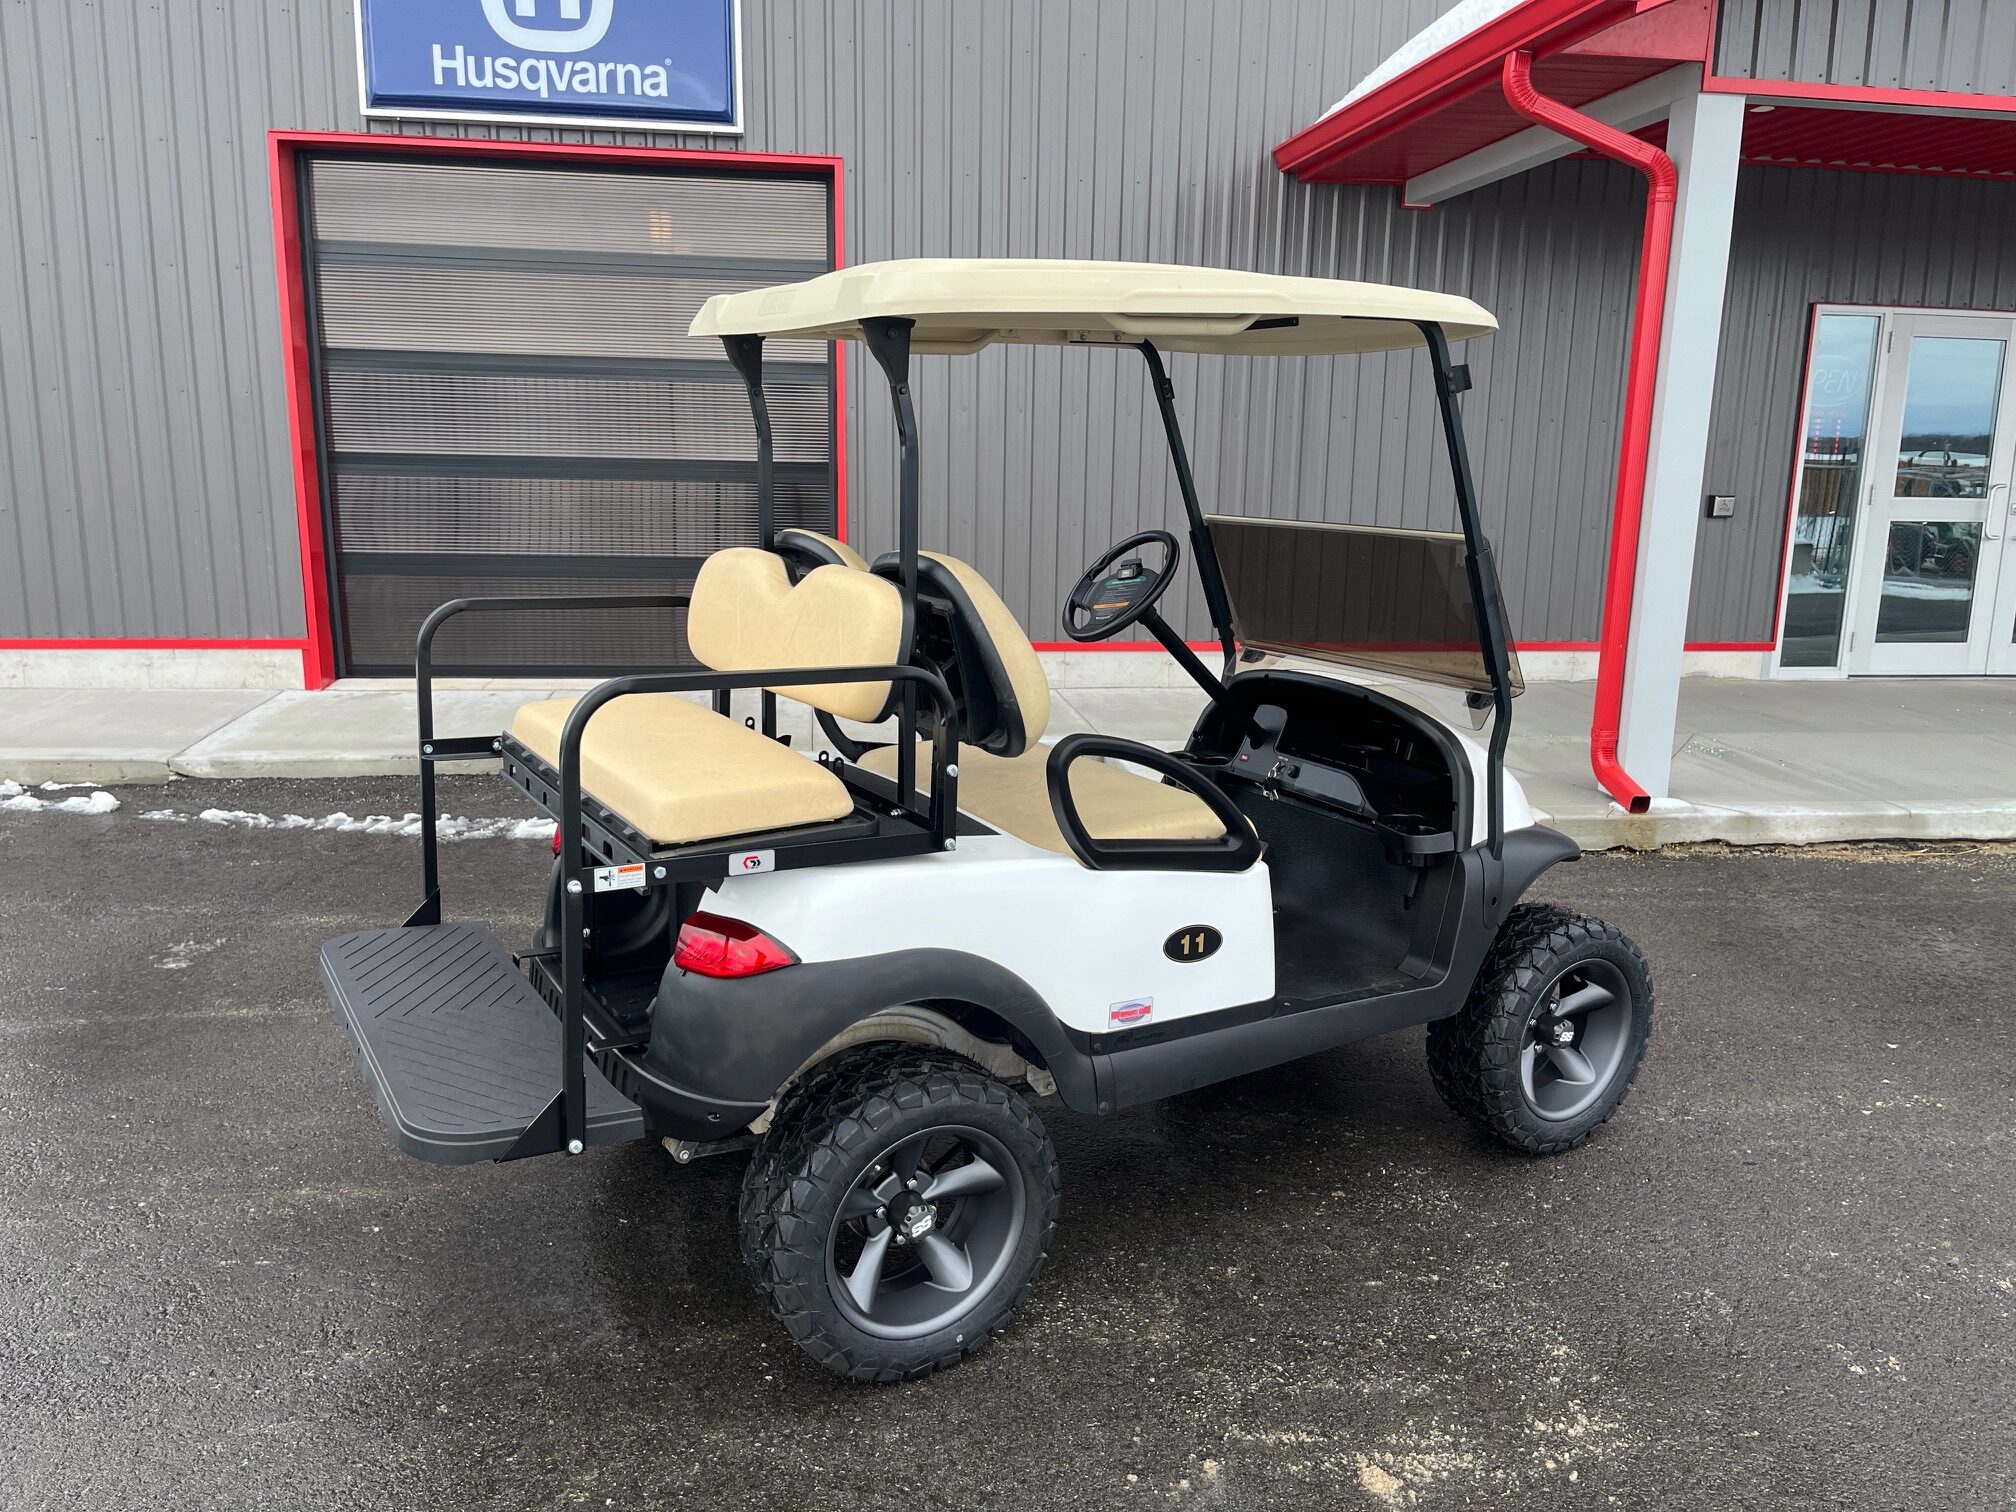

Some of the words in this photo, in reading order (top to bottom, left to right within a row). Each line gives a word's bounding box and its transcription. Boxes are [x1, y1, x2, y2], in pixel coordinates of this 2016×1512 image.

[432, 44, 669, 98] Husqvarna
[1813, 369, 1858, 394] PEN
[1180, 932, 1205, 955] 11
